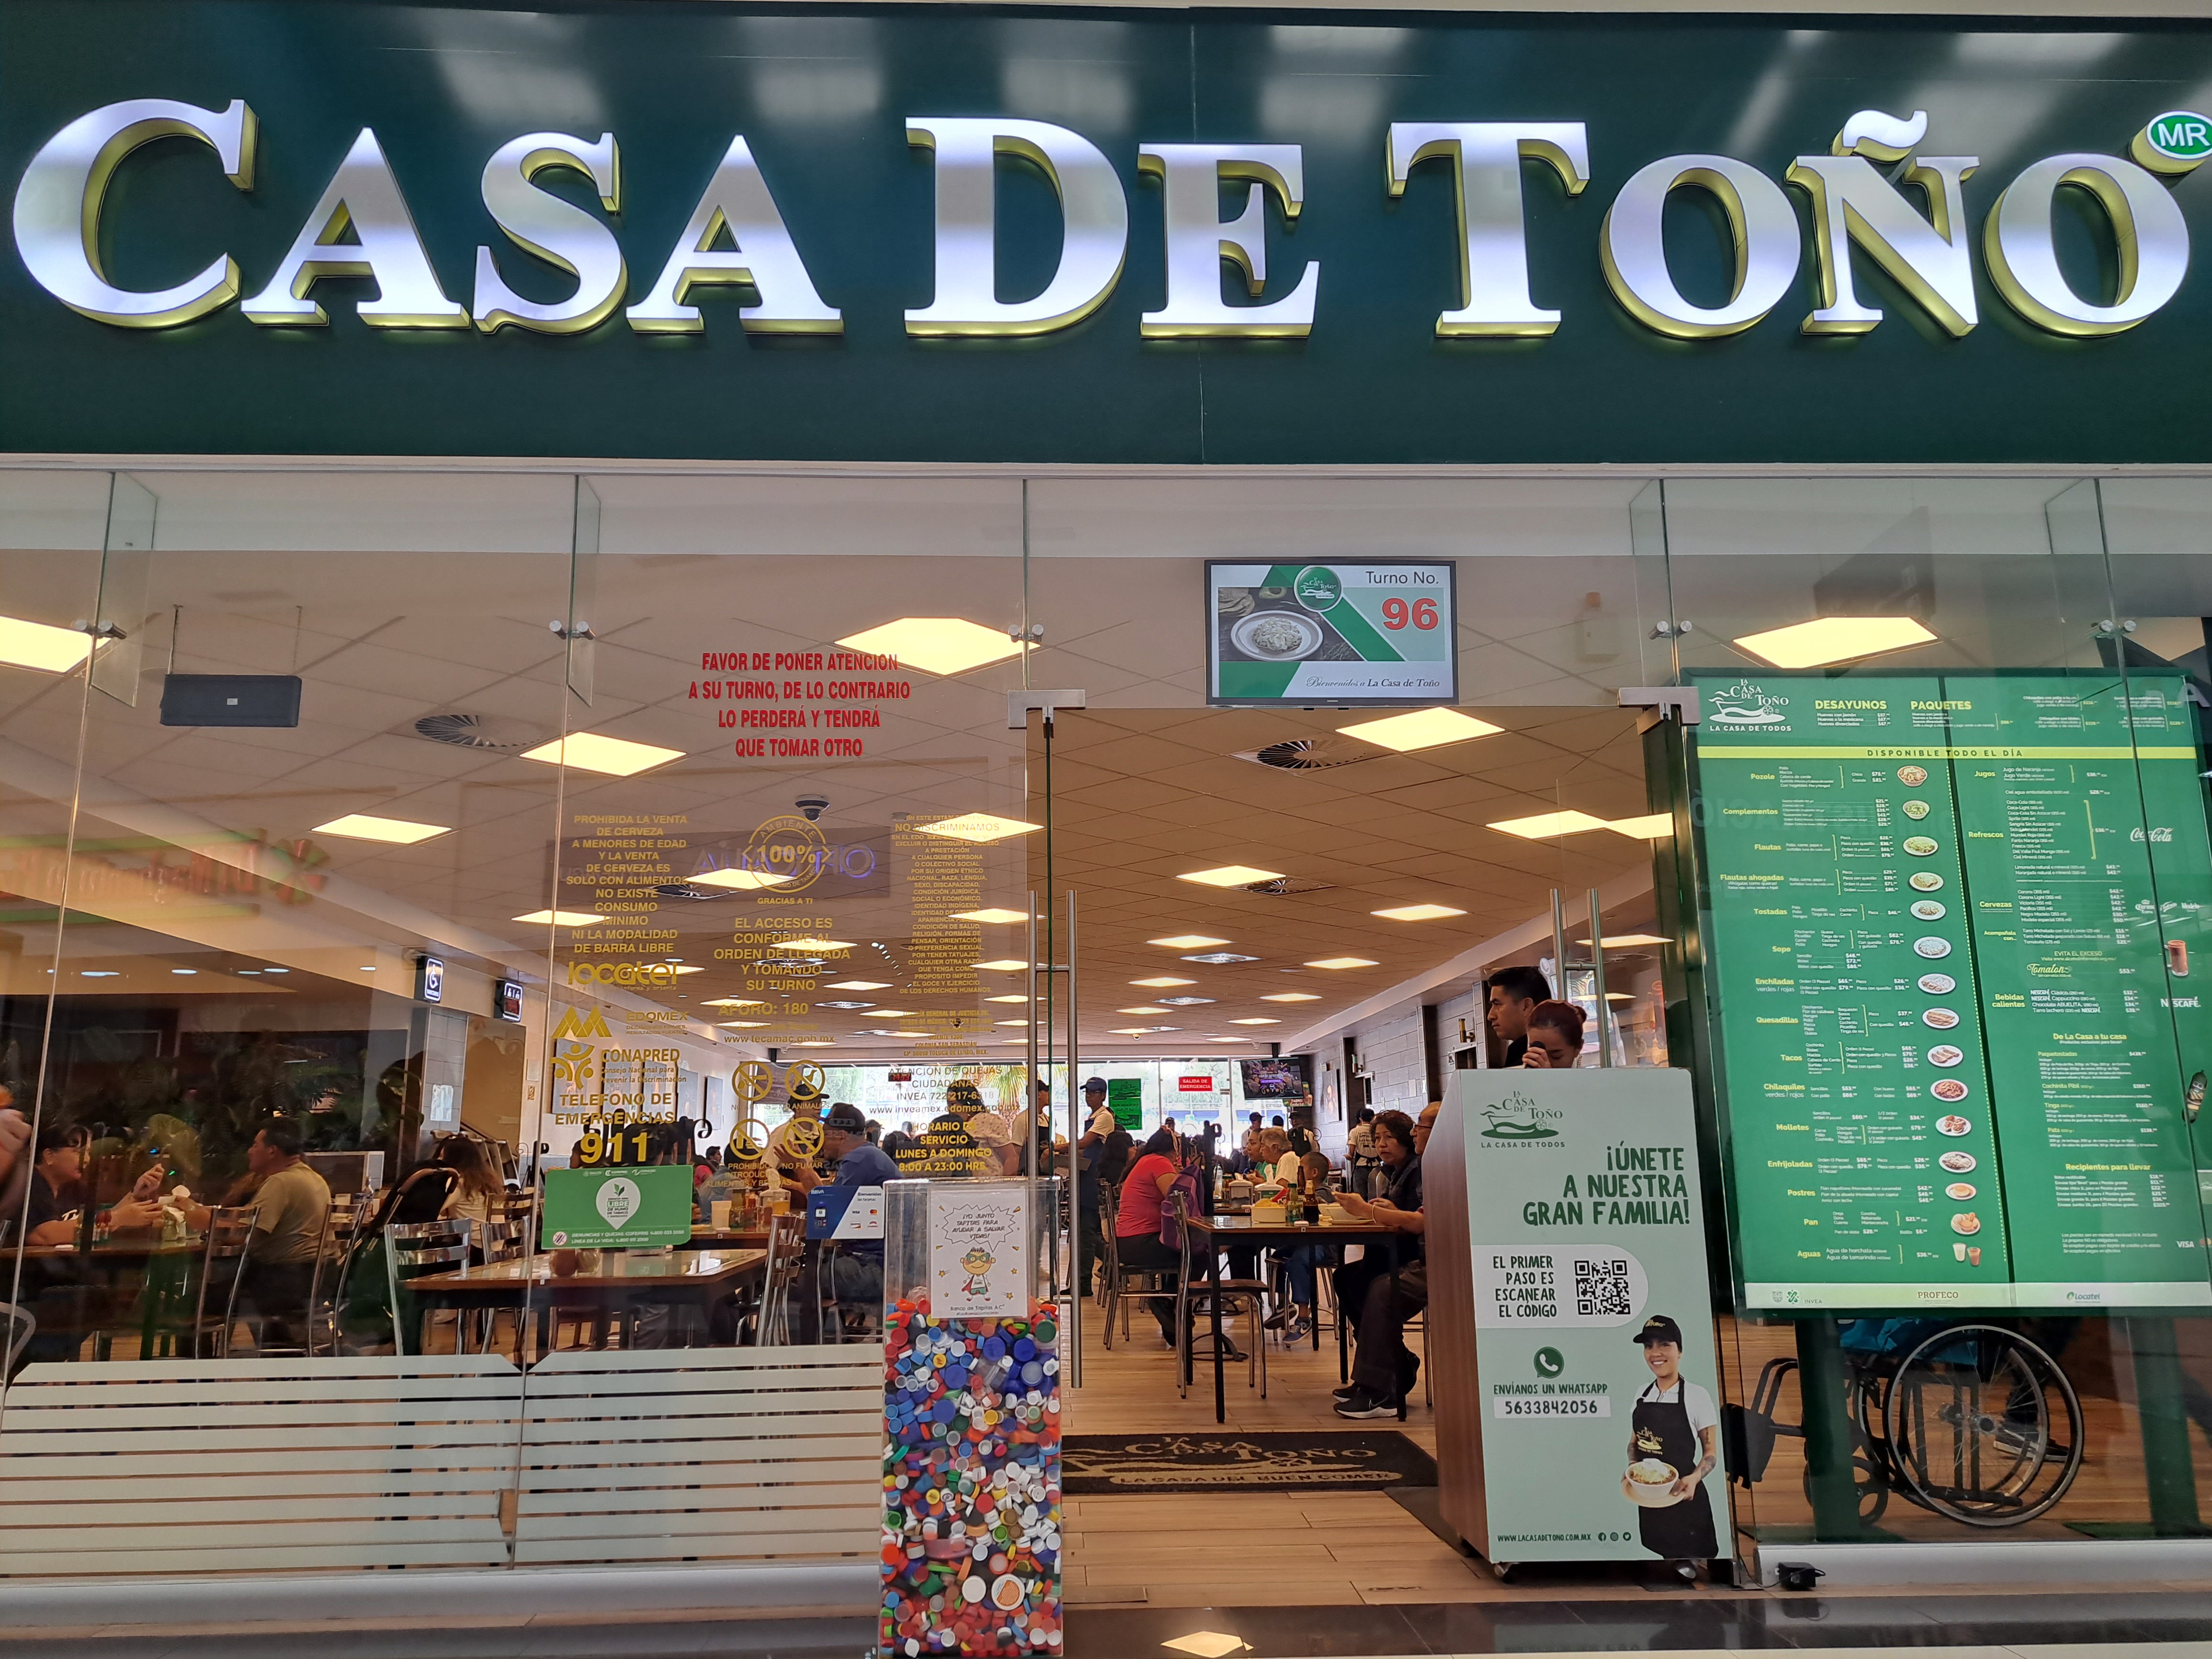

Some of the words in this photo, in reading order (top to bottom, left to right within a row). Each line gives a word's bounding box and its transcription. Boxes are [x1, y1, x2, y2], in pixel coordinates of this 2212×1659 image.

[2157, 123, 2208, 146] MR
[13, 98, 844, 335] CASA
[904, 116, 1319, 339] DE
[1385, 109, 2191, 340] TOÑO
[1366, 571, 1408, 584] Turno
[1414, 571, 1438, 584] No.
[1382, 597, 1438, 630] 96
[702, 653, 748, 671] FAVOR
[752, 653, 770, 670] DE
[775, 653, 822, 671] PONER
[828, 653, 898, 671] ATENCION
[1306, 676, 1358, 688] Bienvenidos
[1367, 678, 1378, 687] La
[1382, 678, 1401, 687] Casa
[1403, 678, 1414, 687] de
[1416, 678, 1440, 687] Toño
[689, 681, 697, 699] A
[702, 681, 720, 699] SU
[726, 681, 778, 702] TURNO,
[784, 681, 801, 699] DE
[807, 681, 823, 699] LO
[829, 681, 910, 699] CONTRARIO
[1730, 686, 1762, 697] CASA
[1755, 695, 1789, 706] TOÑO
[1815, 700, 1887, 710] DESAYUNOS
[1911, 700, 1972, 710] PAQUETES
[719, 710, 736, 727] LO
[741, 705, 806, 727] PERDERÁ
[810, 710, 820, 727] Y
[824, 705, 881, 727] TENDRÁ
[735, 739, 764, 758] QUE
[770, 739, 819, 756] TOMAR
[824, 739, 863, 756] OTRO
[2003, 748, 2023, 756] DÍA
[653, 815, 687, 823] VENTA
[597, 828, 610, 836] DE
[614, 828, 664, 836] CERVEZA
[757, 845, 817, 863] 100%
[586, 864, 601, 872] DE
[604, 864, 653, 872] CERVEZA
[657, 864, 670, 872] ES
[595, 902, 658, 912] CONSUMO
[735, 918, 751, 928] EL
[754, 918, 811, 929] ACCESO
[816, 918, 833, 928] ES
[575, 944, 591, 953] DE
[594, 944, 635, 952] BARRA
[639, 943, 674, 952] LIBRE
[714, 949, 762, 959] ORDEN
[766, 949, 785, 959] DE
[788, 949, 850, 959] LLEGADA
[568, 961, 677, 985] locatel
[747, 980, 764, 991] SU
[769, 980, 816, 991] TURNO
[601, 1049, 680, 1062] CONAPRED
[559, 1094, 645, 1106] TELEFONO
[651, 1093, 671, 1105] DE
[1502, 1098, 1535, 1110] CASA
[555, 1112, 675, 1125] EMERGENCIAS
[1528, 1108, 1562, 1119] TOÑO
[920, 1135, 968, 1144] SERVICIO
[580, 1132, 647, 1163] 911
[896, 1150, 927, 1159] LUNES
[940, 1149, 992, 1158] DOMINGO
[1607, 1140, 1684, 1171] ¡ÚNETE
[1563, 1175, 1578, 1198] A
[1588, 1174, 1688, 1198] NUESTRA
[1523, 1202, 1582, 1226] GRAN
[1593, 1199, 1690, 1225] FAMILIA!
[1493, 1256, 1505, 1269] EL
[1511, 1256, 1553, 1269] PRIMER
[1506, 1272, 1536, 1285] PASO
[1541, 1272, 1554, 1284] ES
[1495, 1288, 1556, 1301] ESCANEAR
[1500, 1305, 1512, 1317] EL
[1517, 1301, 1557, 1317] CÓDIGO
[1494, 1382, 1538, 1394] ENVÍANOS
[1542, 1384, 1554, 1394] UN
[1559, 1383, 1607, 1394] WHATSAPP
[1505, 1400, 1597, 1414] 5633842056
